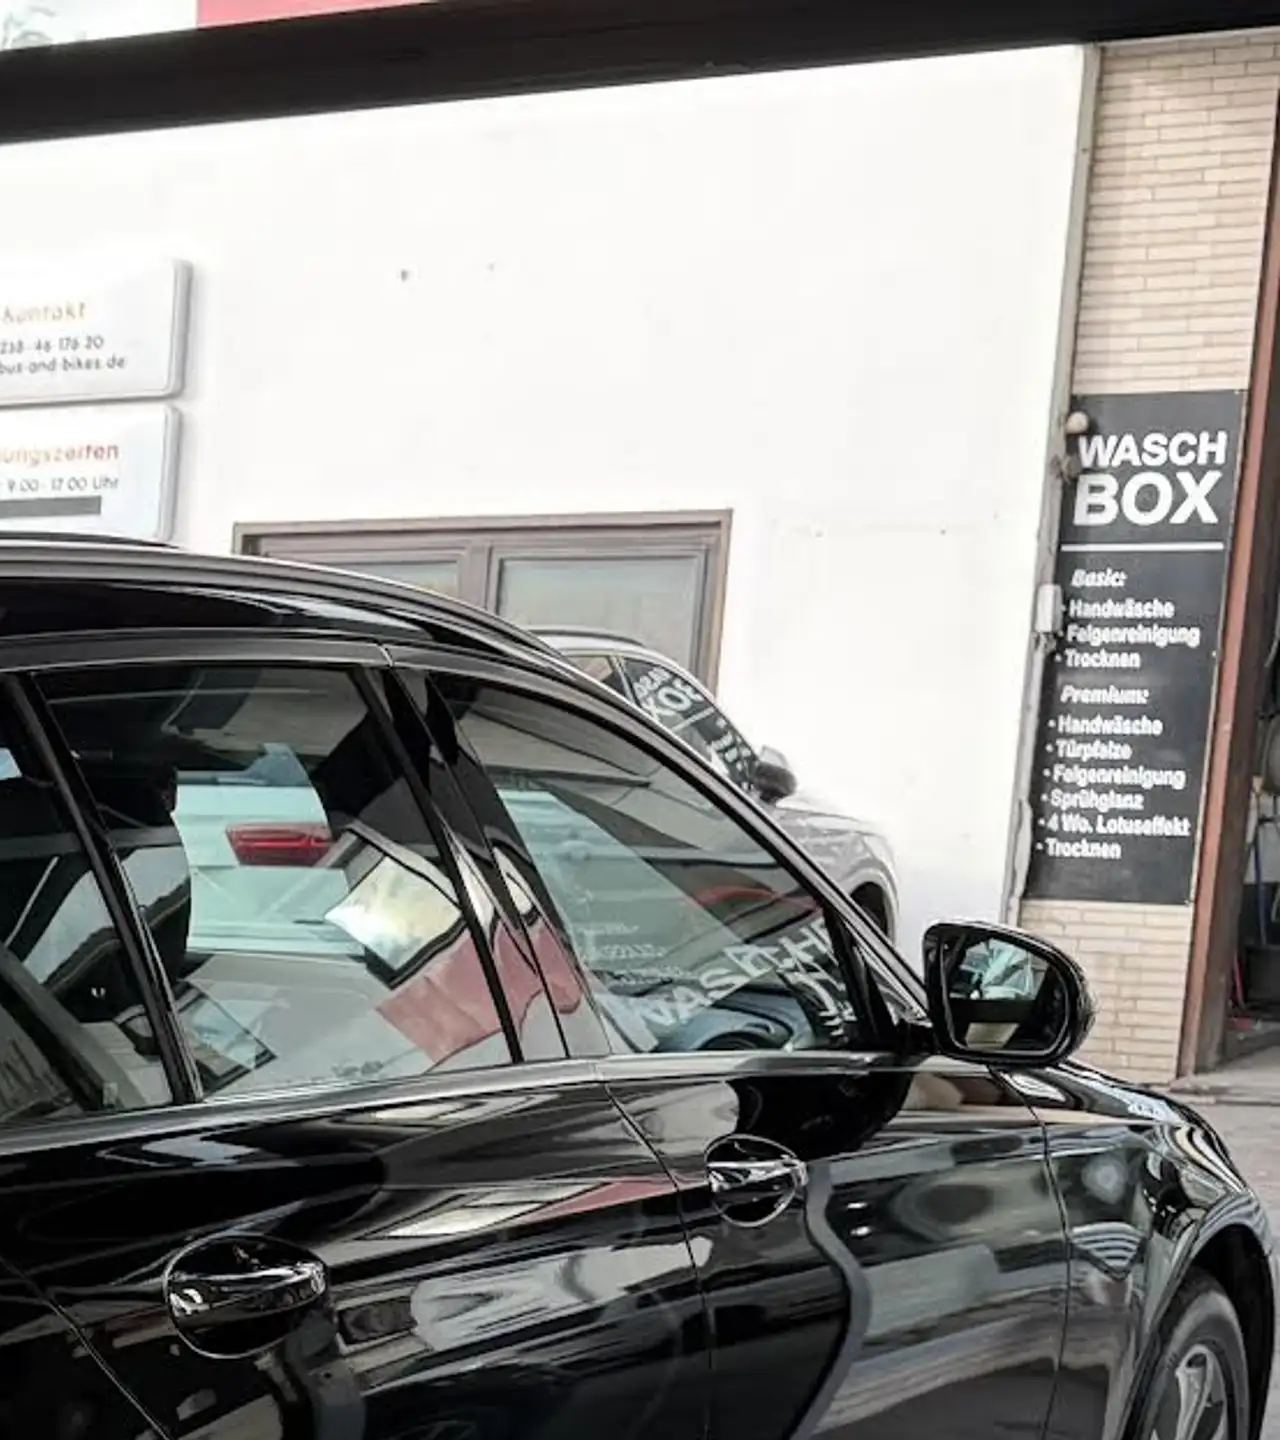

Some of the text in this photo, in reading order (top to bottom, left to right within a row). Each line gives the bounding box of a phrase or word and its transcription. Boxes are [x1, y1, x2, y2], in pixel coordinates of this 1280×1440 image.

[1077, 431, 1228, 468] WASCH
[1073, 469, 1223, 526] BOX
[1070, 568, 1127, 588] Basic:
[1068, 599, 1175, 618] Handwäsche
[1066, 624, 1201, 646] Felgenreinigung
[1064, 649, 1141, 668] Trocknen
[1060, 685, 1149, 704] Premium:
[1057, 714, 1164, 735] Handwäsche
[1053, 764, 1186, 789] Felgenreinigung
[1047, 815, 1059, 832] 4
[1096, 815, 1190, 836] Lotuseffekt
[1046, 837, 1122, 859] Trocknen
